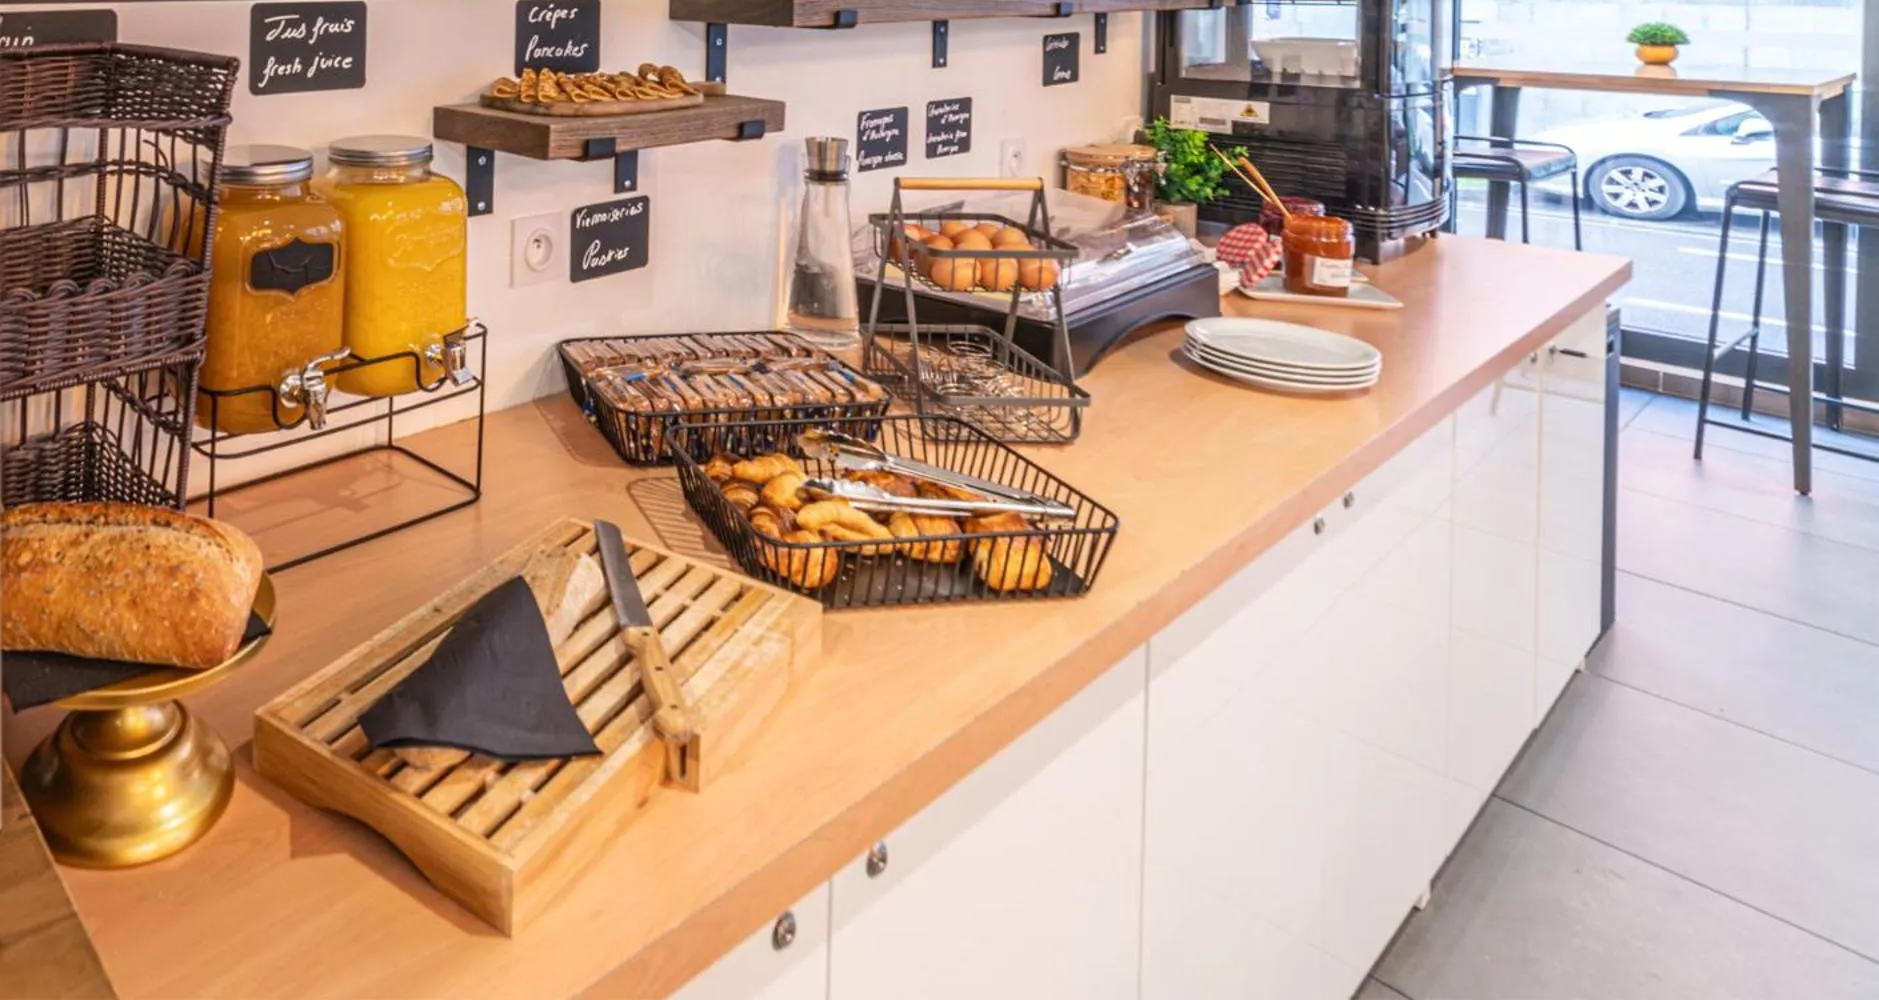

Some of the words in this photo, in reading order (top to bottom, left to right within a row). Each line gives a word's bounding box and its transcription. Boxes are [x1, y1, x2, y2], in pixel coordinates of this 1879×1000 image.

[308, 16, 355, 44] frais
[524, 34, 589, 62] Pancakes
[258, 56, 302, 87] fresh
[307, 52, 353, 78] juice
